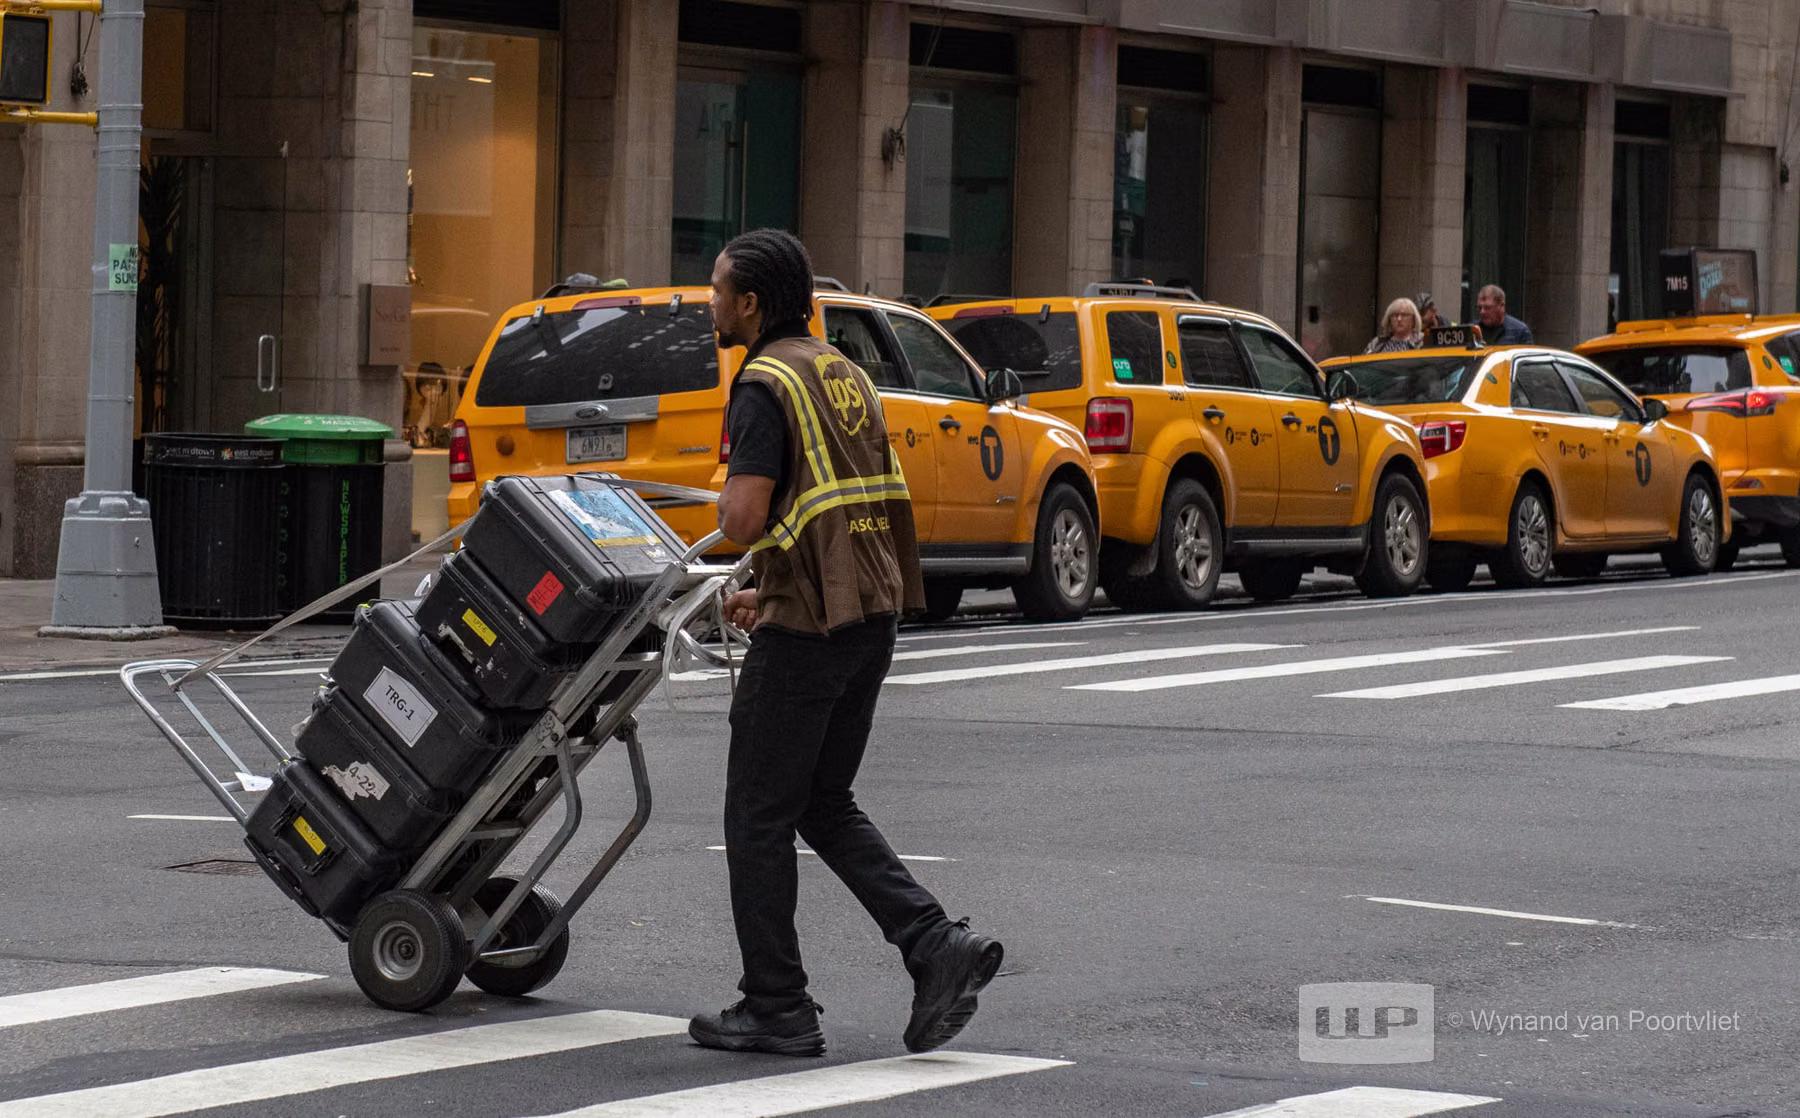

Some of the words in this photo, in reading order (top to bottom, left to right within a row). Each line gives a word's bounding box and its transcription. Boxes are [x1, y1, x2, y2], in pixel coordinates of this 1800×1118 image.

[1666, 276, 1688, 292] 7M15
[1436, 330, 1465, 345] 9C30
[385, 684, 415, 721] TRG-1
